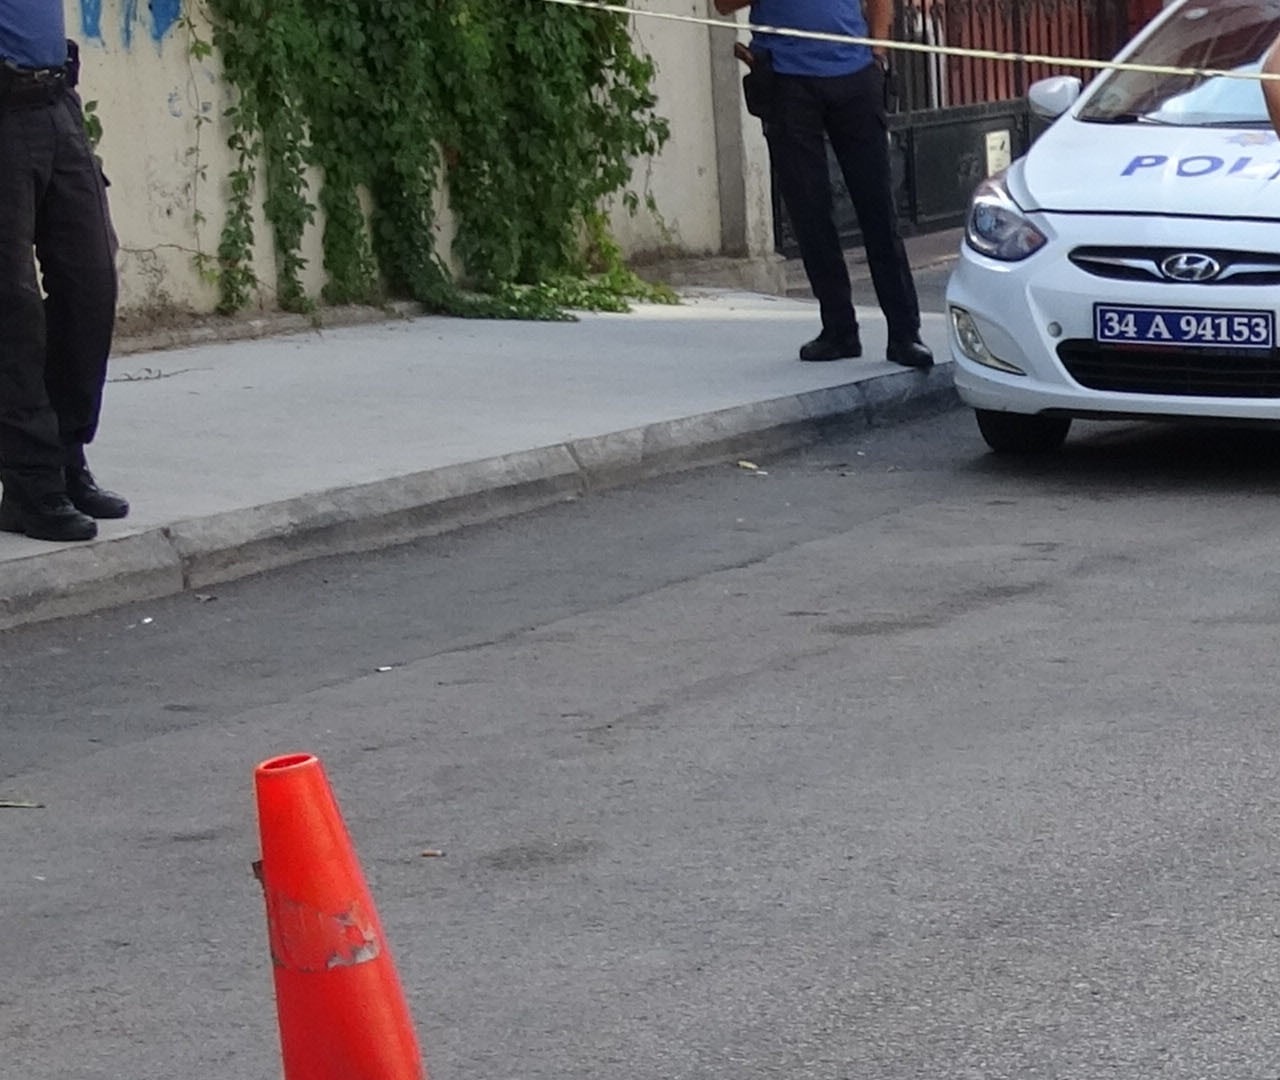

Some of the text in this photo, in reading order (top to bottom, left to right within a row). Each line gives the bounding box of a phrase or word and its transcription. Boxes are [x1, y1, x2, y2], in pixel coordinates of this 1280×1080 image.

[1104, 312, 1268, 342] 34 A 94153
